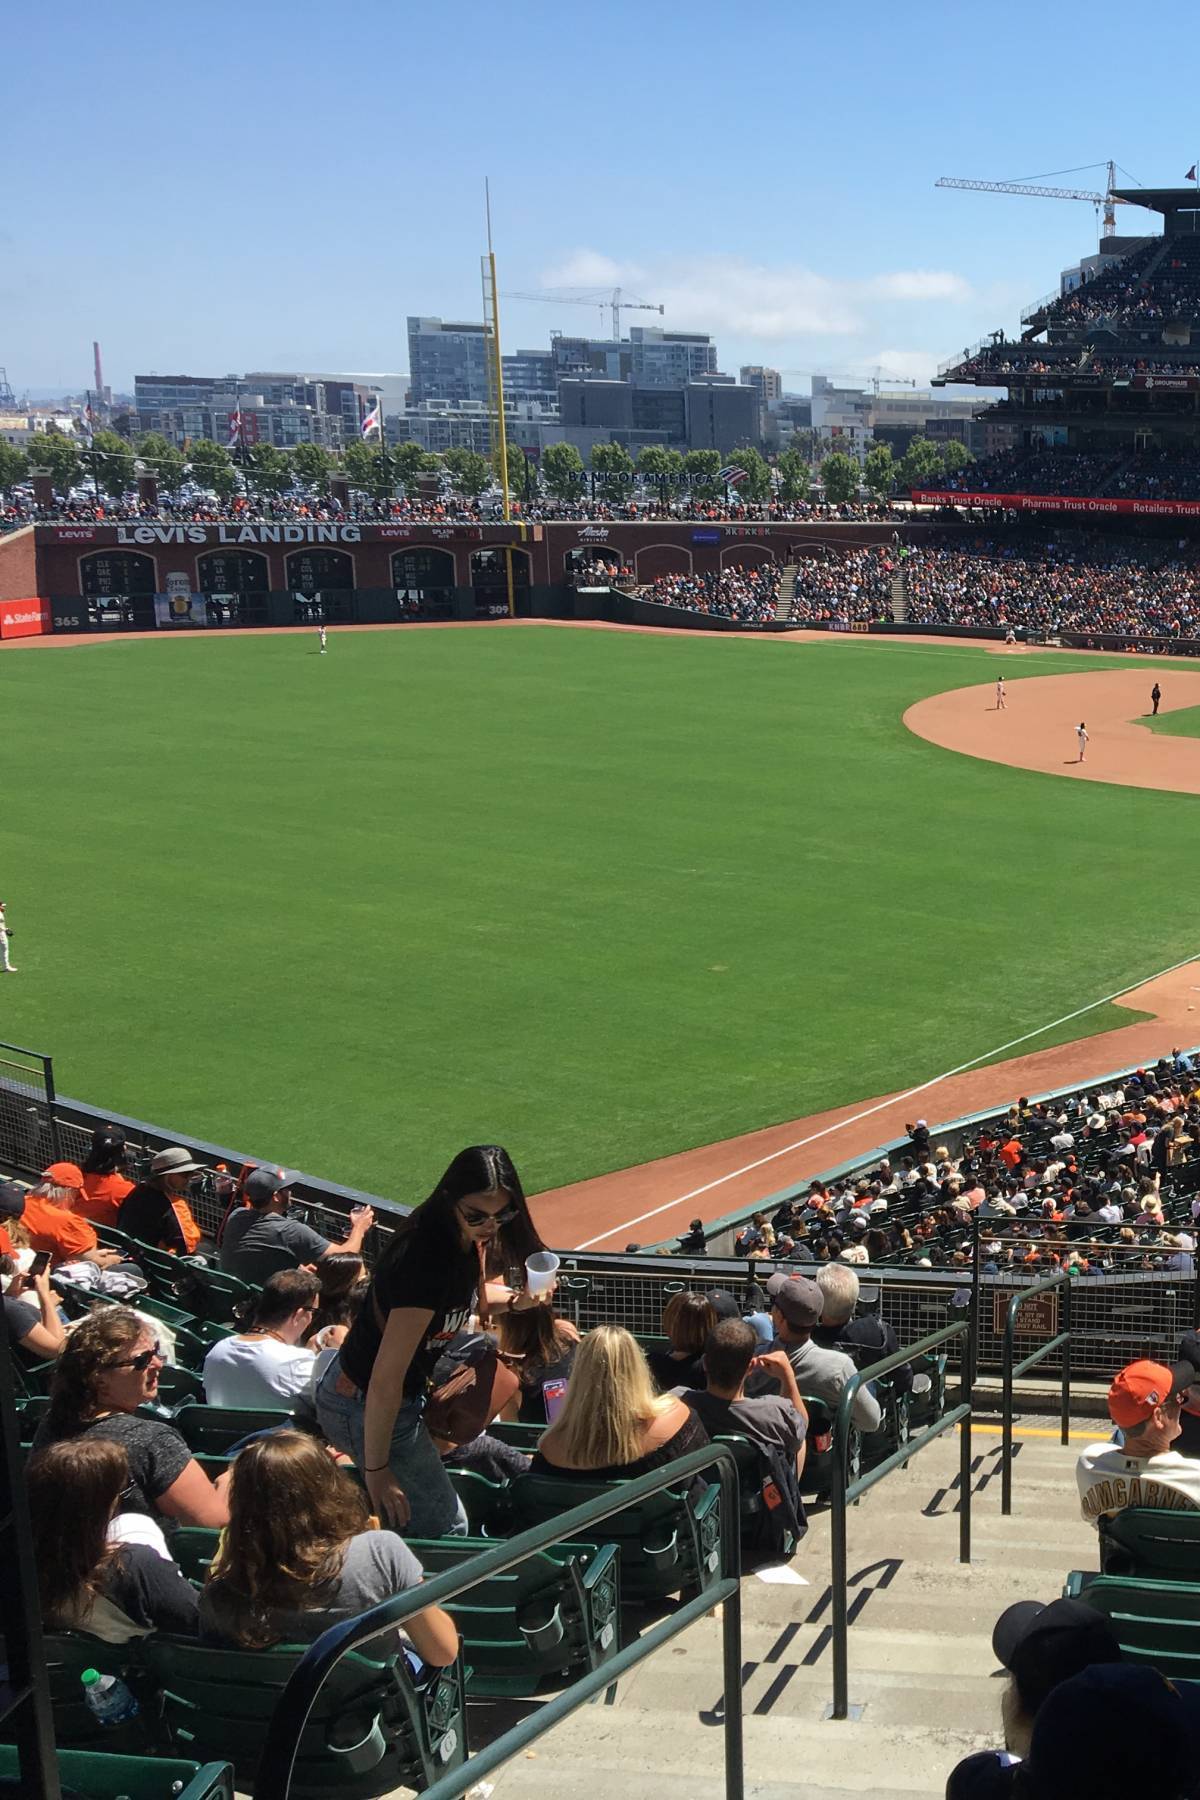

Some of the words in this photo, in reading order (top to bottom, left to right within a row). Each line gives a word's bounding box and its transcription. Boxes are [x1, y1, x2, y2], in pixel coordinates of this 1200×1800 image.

[568, 471, 613, 483] BANK
[619, 472, 640, 483] OF
[643, 472, 714, 485] AMERICA
[920, 494, 947, 505] Banks
[949, 495, 972, 505] Trust
[974, 496, 1002, 507] Oracle
[1022, 498, 1061, 509] Pharmas
[1062, 499, 1086, 510] Trust
[1088, 500, 1118, 512] Oracle
[1133, 502, 1174, 514] Retailers
[1176, 503, 1200, 515] Trust
[218, 525, 362, 543] LANDING
[577, 526, 610, 538] Alaska
[488, 605, 509, 615] 309
[54, 616, 80, 627] 365
[829, 622, 852, 631] KNBR
[852, 622, 868, 631] 680
